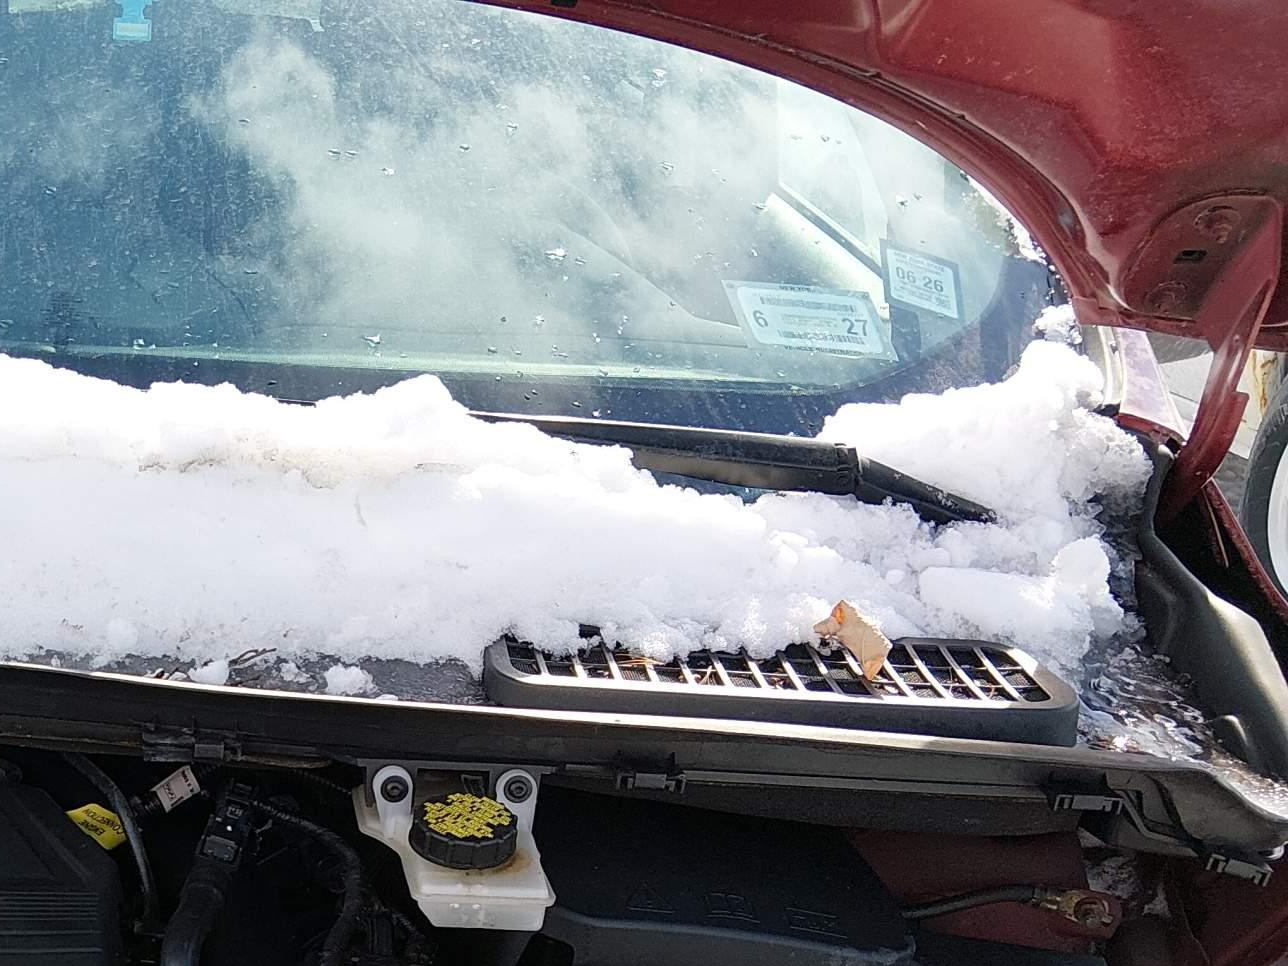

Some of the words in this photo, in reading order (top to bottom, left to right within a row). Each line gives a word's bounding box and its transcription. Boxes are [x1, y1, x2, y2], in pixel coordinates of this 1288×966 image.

[895, 266, 916, 283] 06
[922, 275, 944, 292] 26
[753, 309, 769, 328] 6
[841, 318, 868, 337] 27
